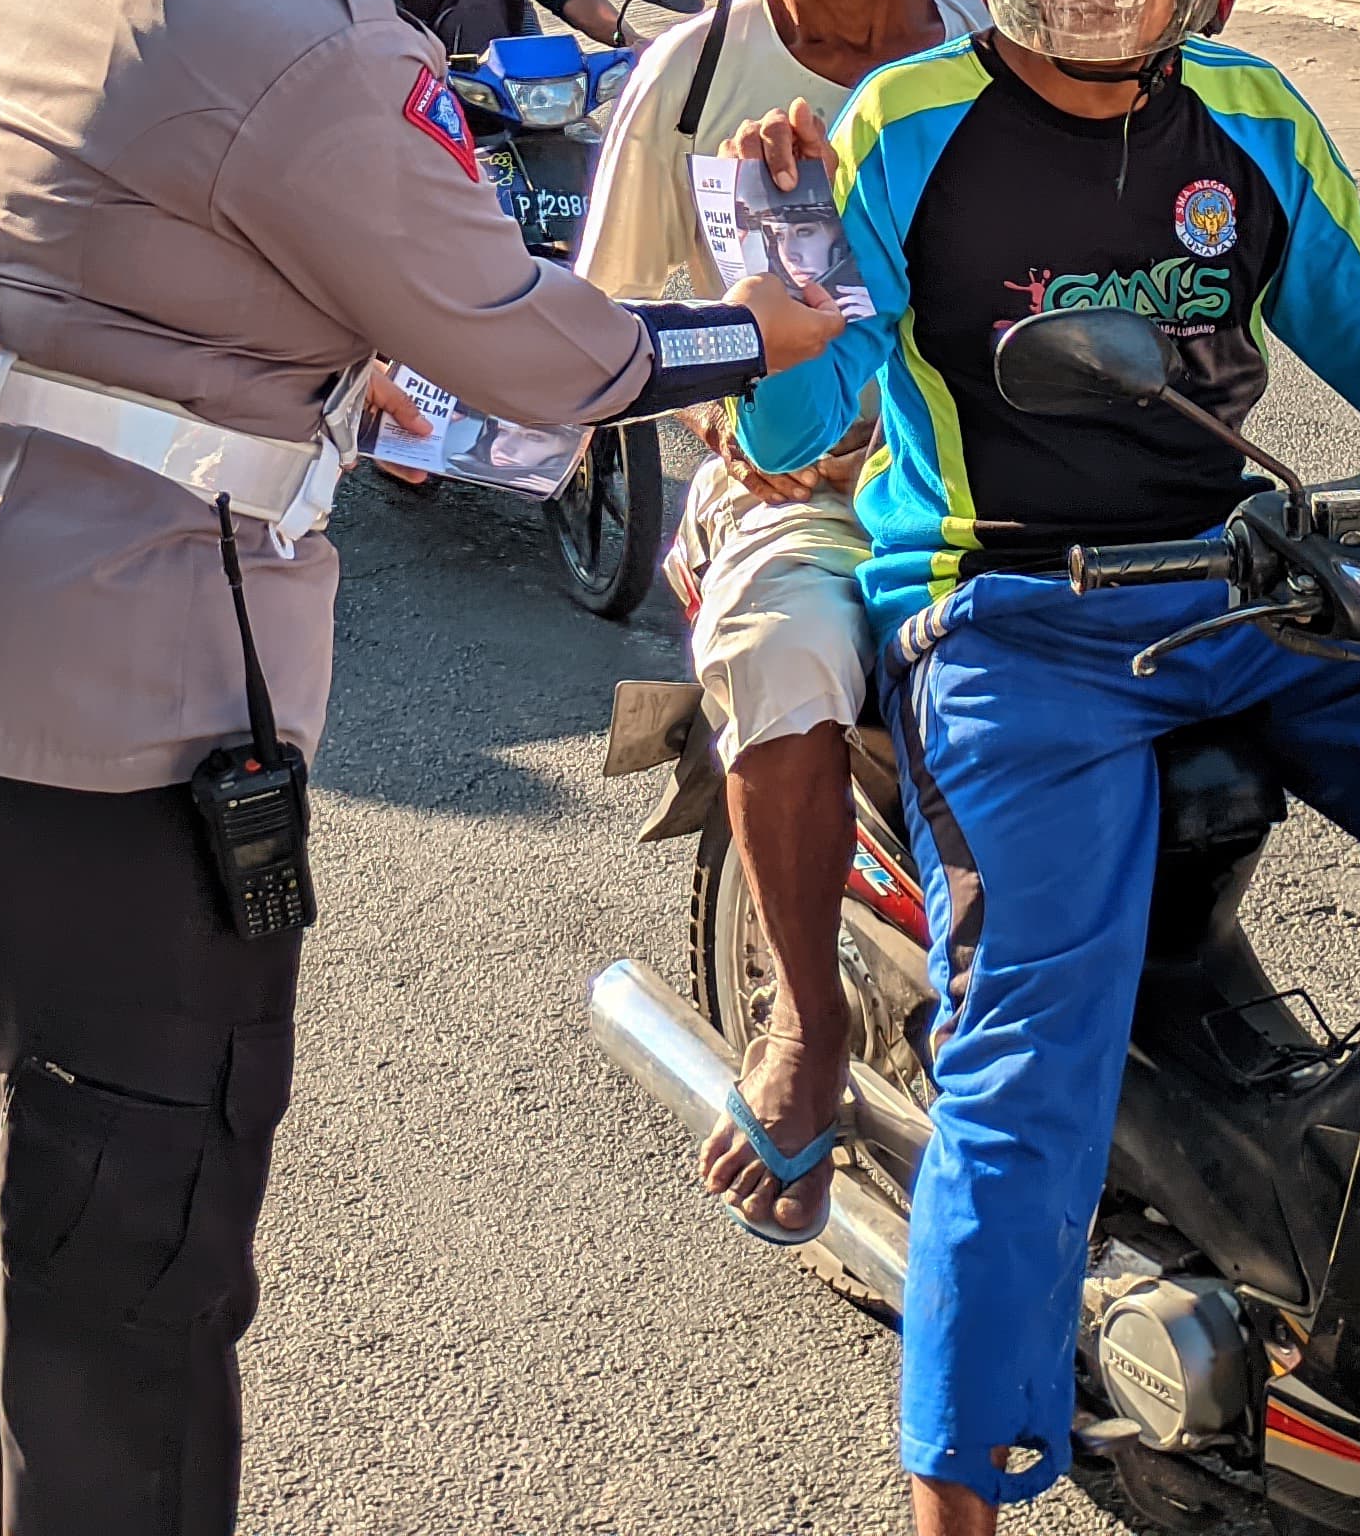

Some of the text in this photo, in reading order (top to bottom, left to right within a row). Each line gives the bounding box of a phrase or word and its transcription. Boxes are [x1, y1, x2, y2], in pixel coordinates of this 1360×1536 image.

[516, 195, 531, 220] P
[1175, 189, 1191, 213] SMA
[703, 209, 732, 225] PILIH
[707, 224, 736, 240] HELM
[711, 239, 727, 253] SNI
[405, 376, 451, 405] PILIH
[409, 395, 450, 419] ELM
[1107, 1347, 1176, 1404] HONDA
